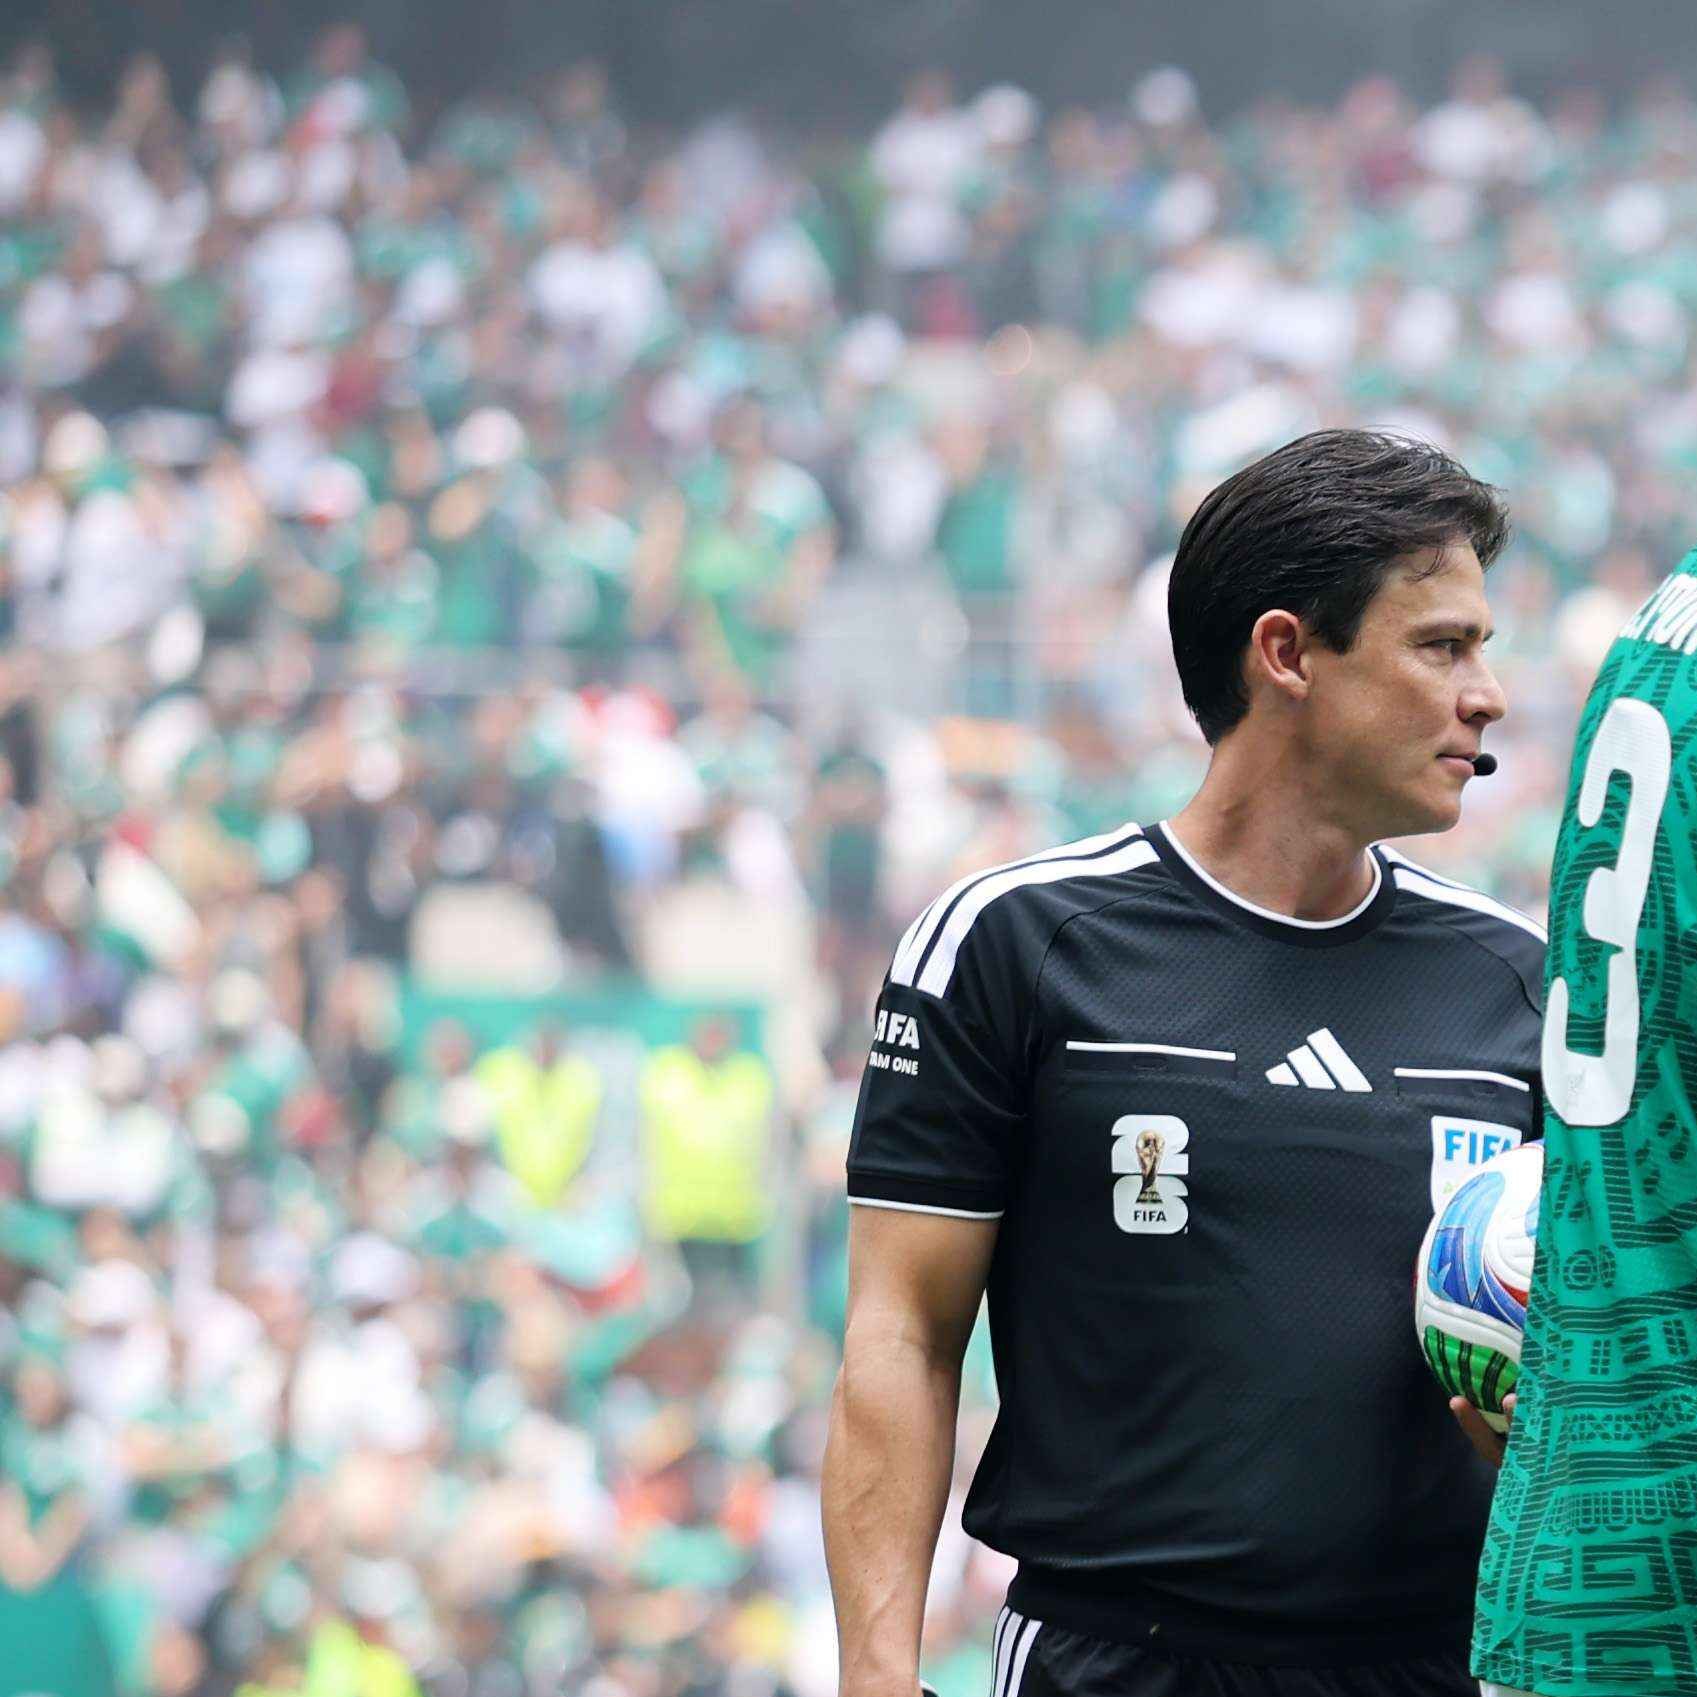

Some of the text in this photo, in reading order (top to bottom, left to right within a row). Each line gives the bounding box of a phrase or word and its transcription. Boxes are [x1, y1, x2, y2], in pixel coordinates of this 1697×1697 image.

[1541, 697, 1671, 1127] 3
[874, 1009, 920, 1050] IFA
[892, 1057, 918, 1075] ONE
[1133, 1210, 1167, 1222] FIFA
